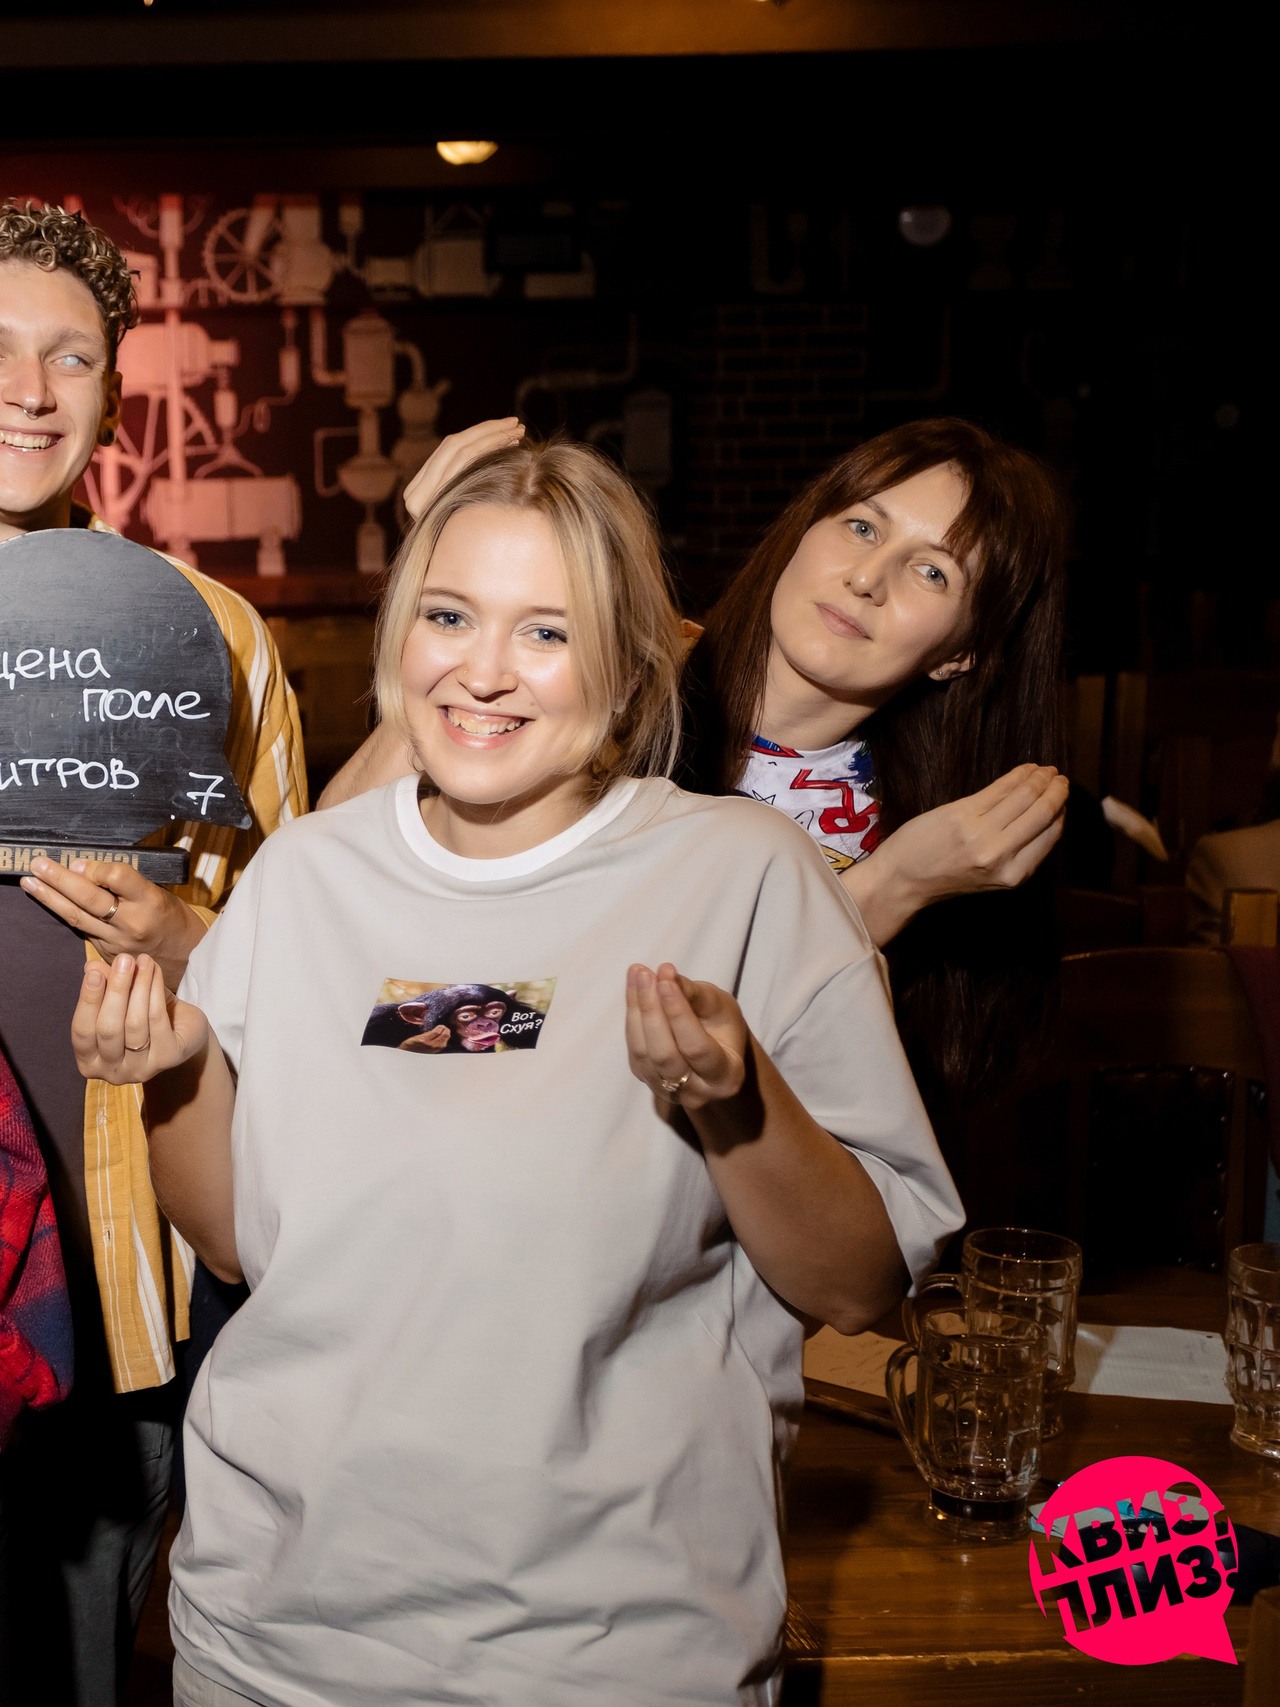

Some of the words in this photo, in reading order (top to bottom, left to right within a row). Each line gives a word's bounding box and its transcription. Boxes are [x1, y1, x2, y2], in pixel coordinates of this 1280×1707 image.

[82, 688, 211, 722] после
[186, 772, 225, 816] 7
[500, 1018, 543, 1034] Схуя?
[511, 1011, 536, 1022] Вот
